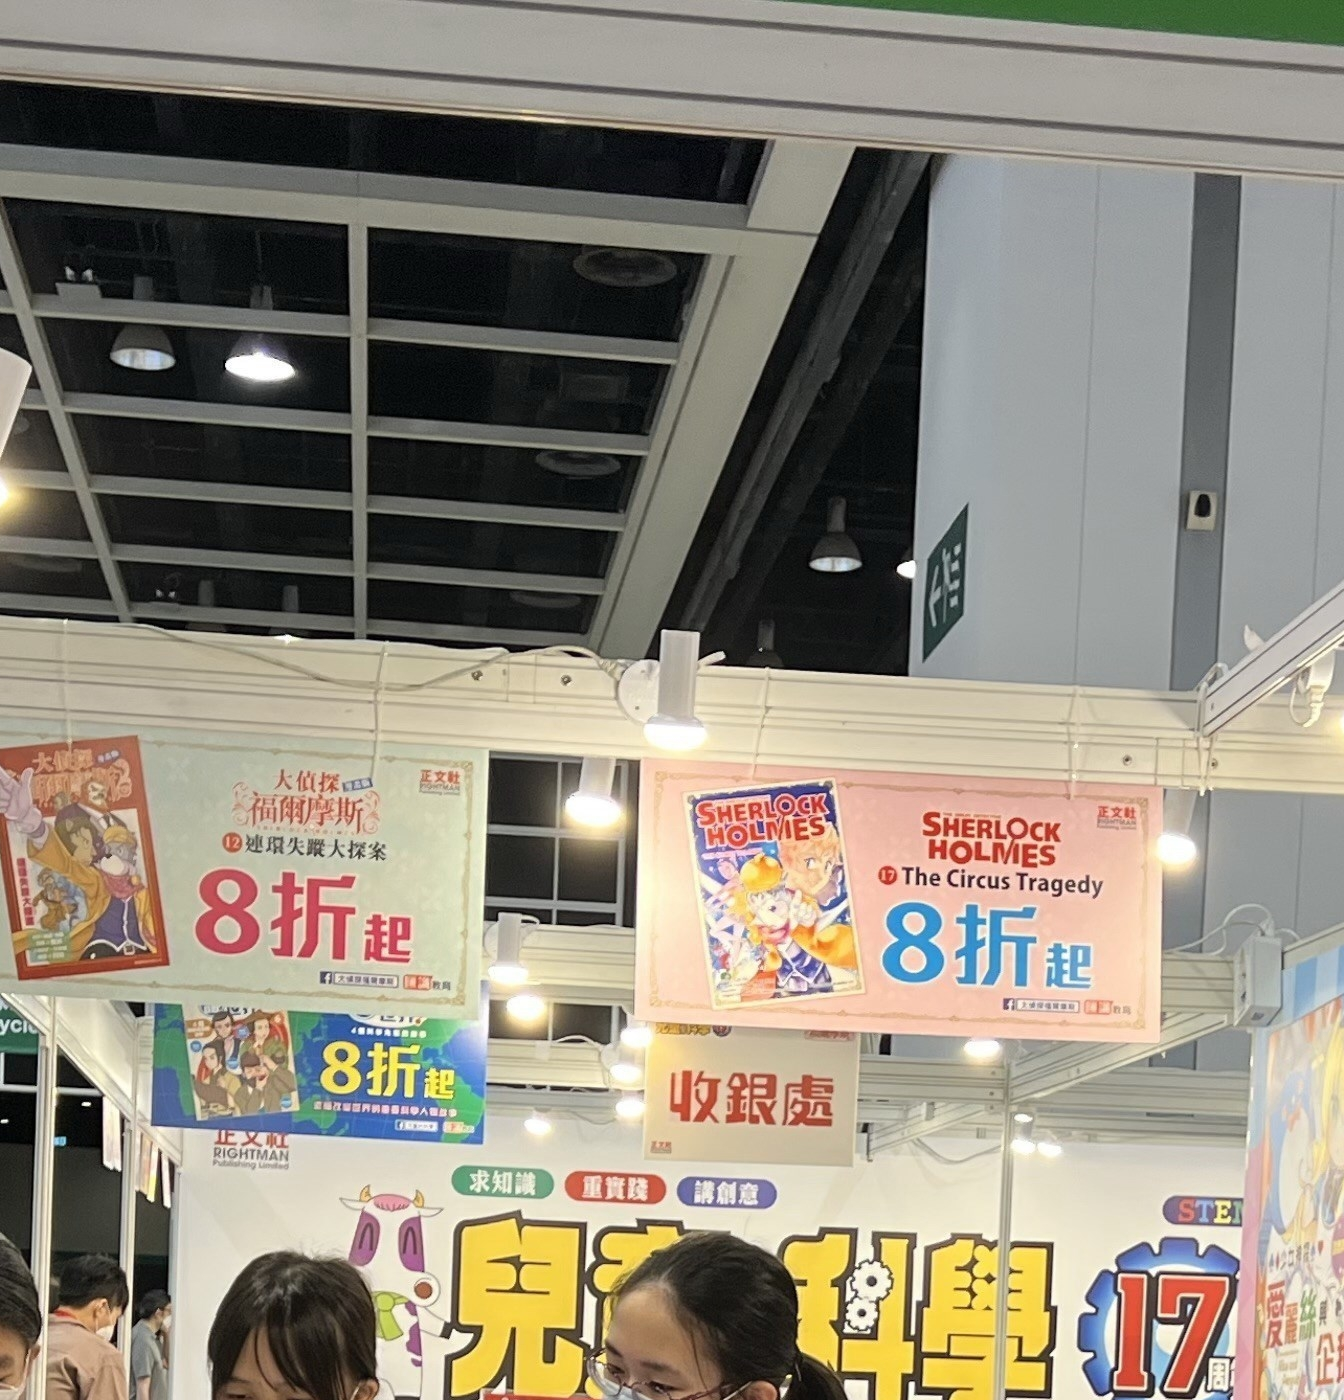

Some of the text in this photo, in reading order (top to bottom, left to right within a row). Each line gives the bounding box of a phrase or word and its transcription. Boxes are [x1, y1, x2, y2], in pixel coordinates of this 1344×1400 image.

[273, 768, 340, 793] 大偵探
[420, 769, 460, 785] 正文社
[248, 791, 364, 834] 福爾摩斯
[697, 794, 828, 826] SHERLOCK
[1097, 805, 1136, 819] 正文社
[706, 815, 826, 848] HOLMES
[922, 811, 1062, 843] SHERLOCK
[245, 833, 387, 862] 連環失蹤大探案
[928, 838, 1056, 868] HOLMES
[902, 867, 941, 887] The
[947, 869, 1010, 890] Circus
[1016, 872, 1104, 900] Tragedy
[194, 866, 412, 964] 8折起
[882, 901, 1092, 989] 8折起
[319, 1040, 456, 1100] 8折起
[669, 1070, 834, 1127] 收銀處
[212, 1147, 289, 1162] RIGHTMAN
[212, 1159, 289, 1171] Publishing Limited
[468, 1168, 537, 1196] 求知識
[582, 1173, 649, 1201] 重實踐
[694, 1179, 760, 1206] 講創意
[1265, 1281, 1329, 1349] 愛麗絲與
[1112, 1271, 1233, 1395] 17
